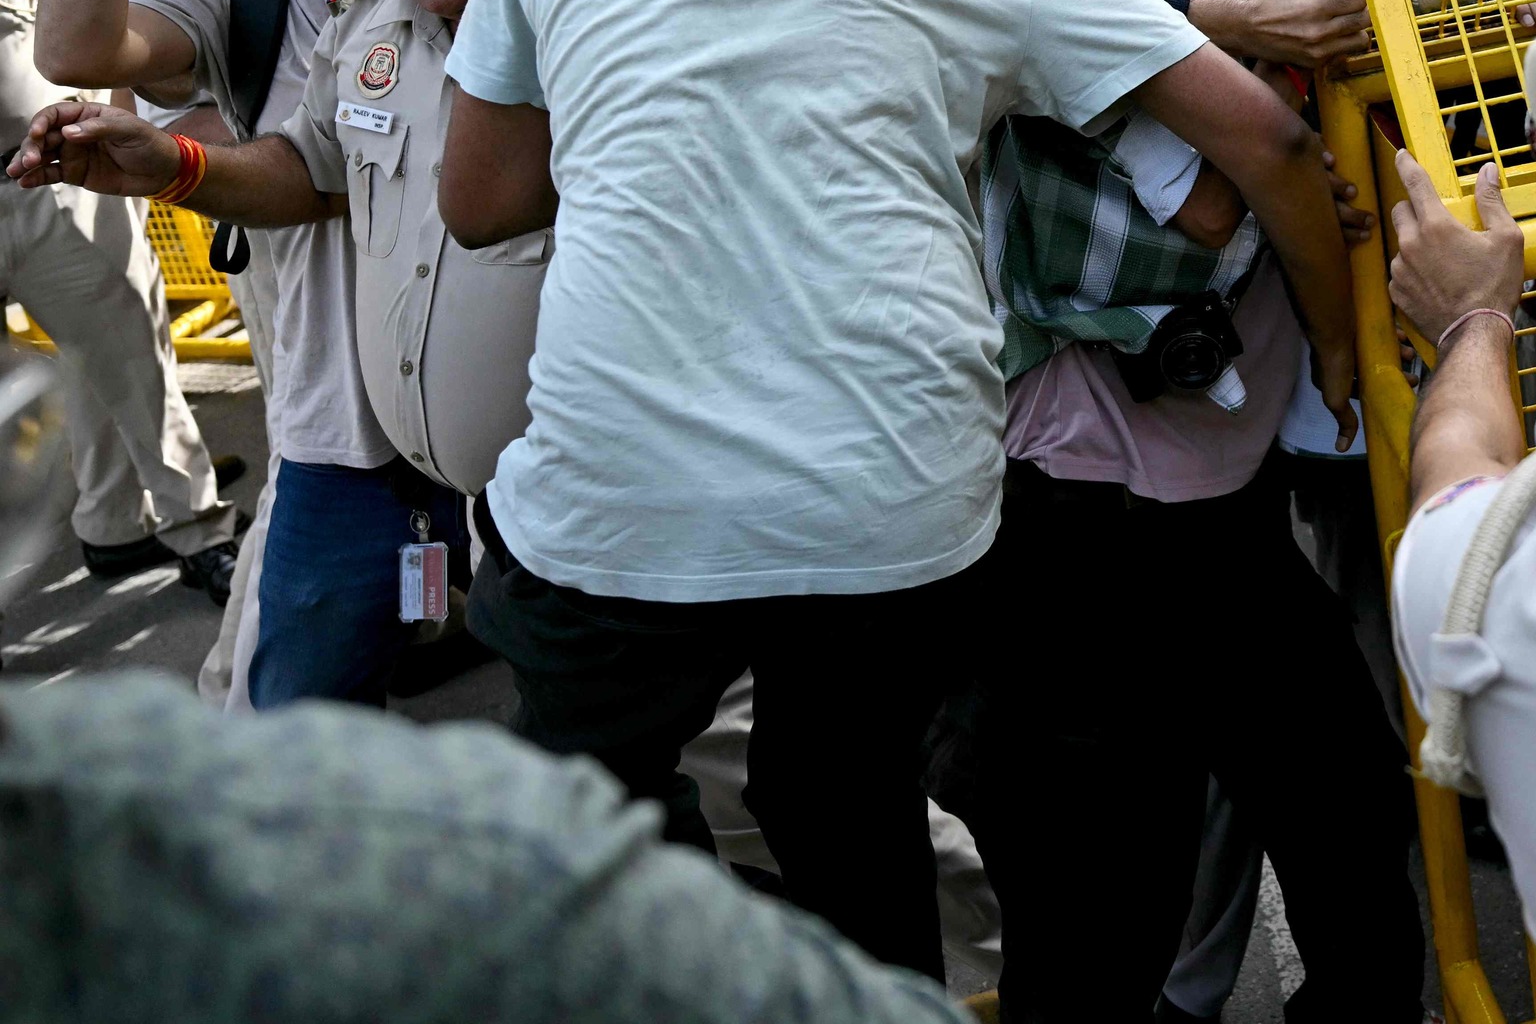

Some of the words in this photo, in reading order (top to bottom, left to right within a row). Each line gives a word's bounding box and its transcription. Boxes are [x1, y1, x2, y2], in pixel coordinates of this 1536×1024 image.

[353, 108, 370, 118] RAJEEV
[372, 113, 388, 122] KUMAR
[428, 586, 436, 615] PRESS
